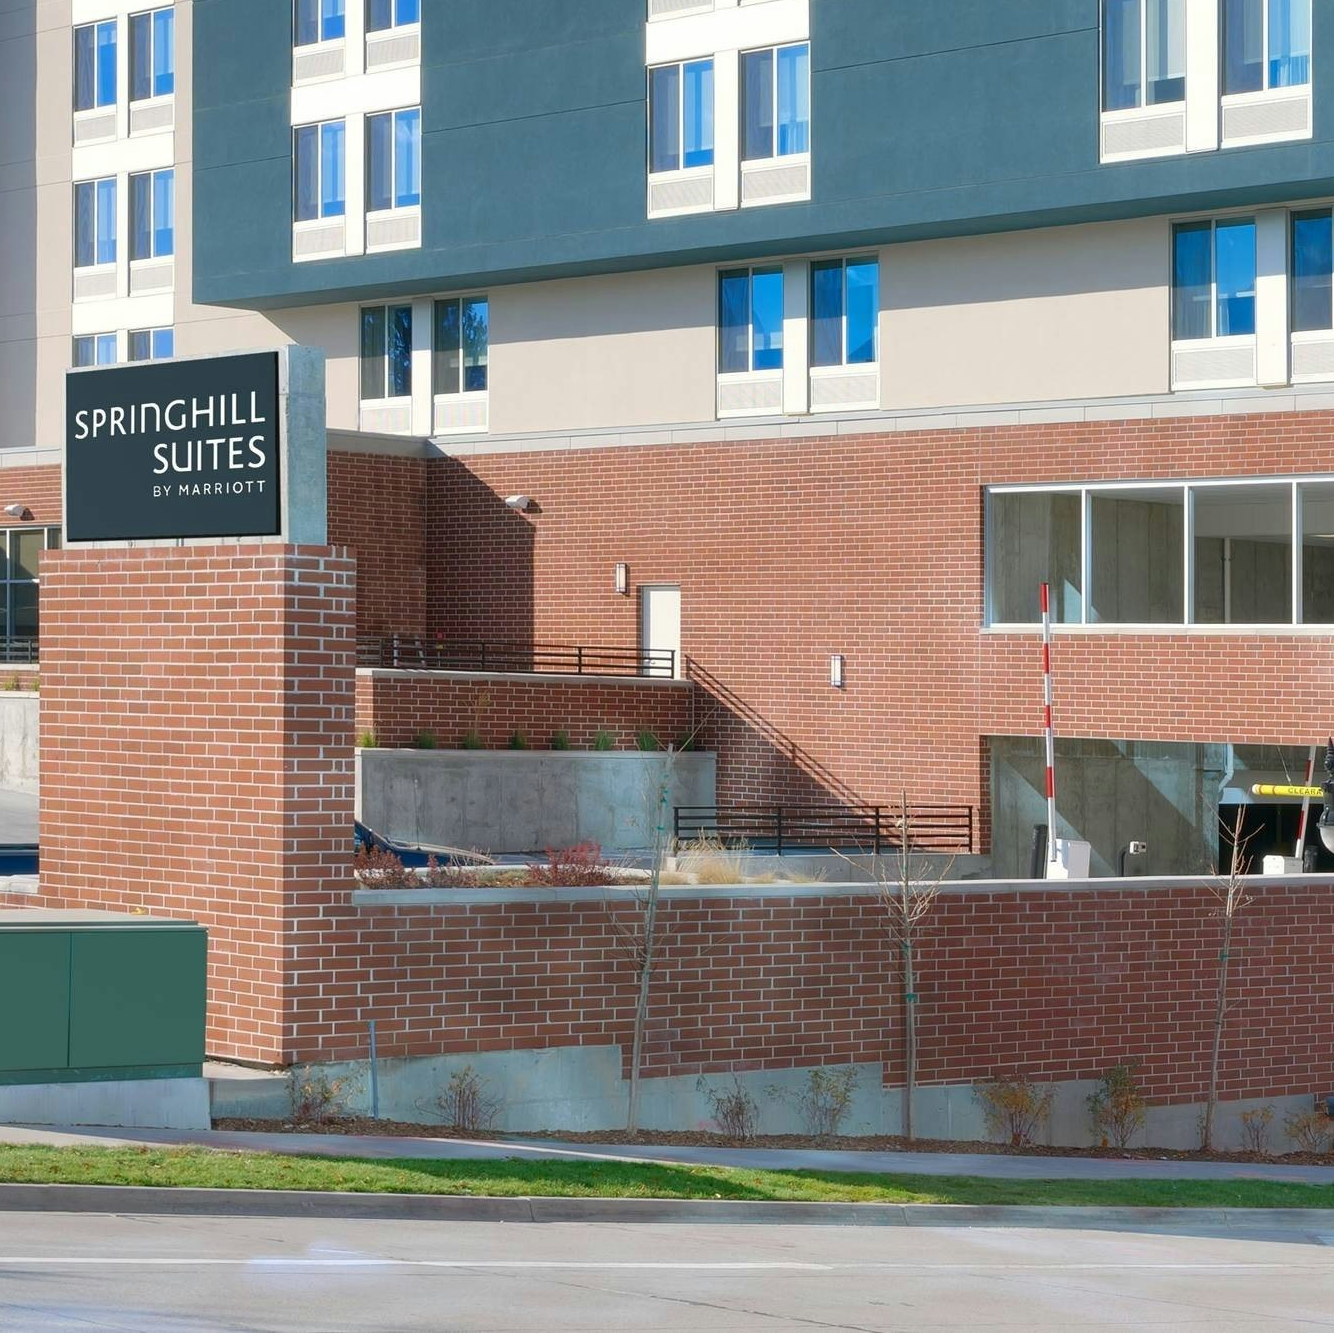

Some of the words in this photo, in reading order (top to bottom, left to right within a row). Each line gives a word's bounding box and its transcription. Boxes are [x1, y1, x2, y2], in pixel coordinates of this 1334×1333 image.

[74, 390, 266, 440] SPRINGHILL
[153, 435, 266, 475] SUITES
[153, 485, 171, 497] BY
[178, 480, 266, 497] MARRIOTT
